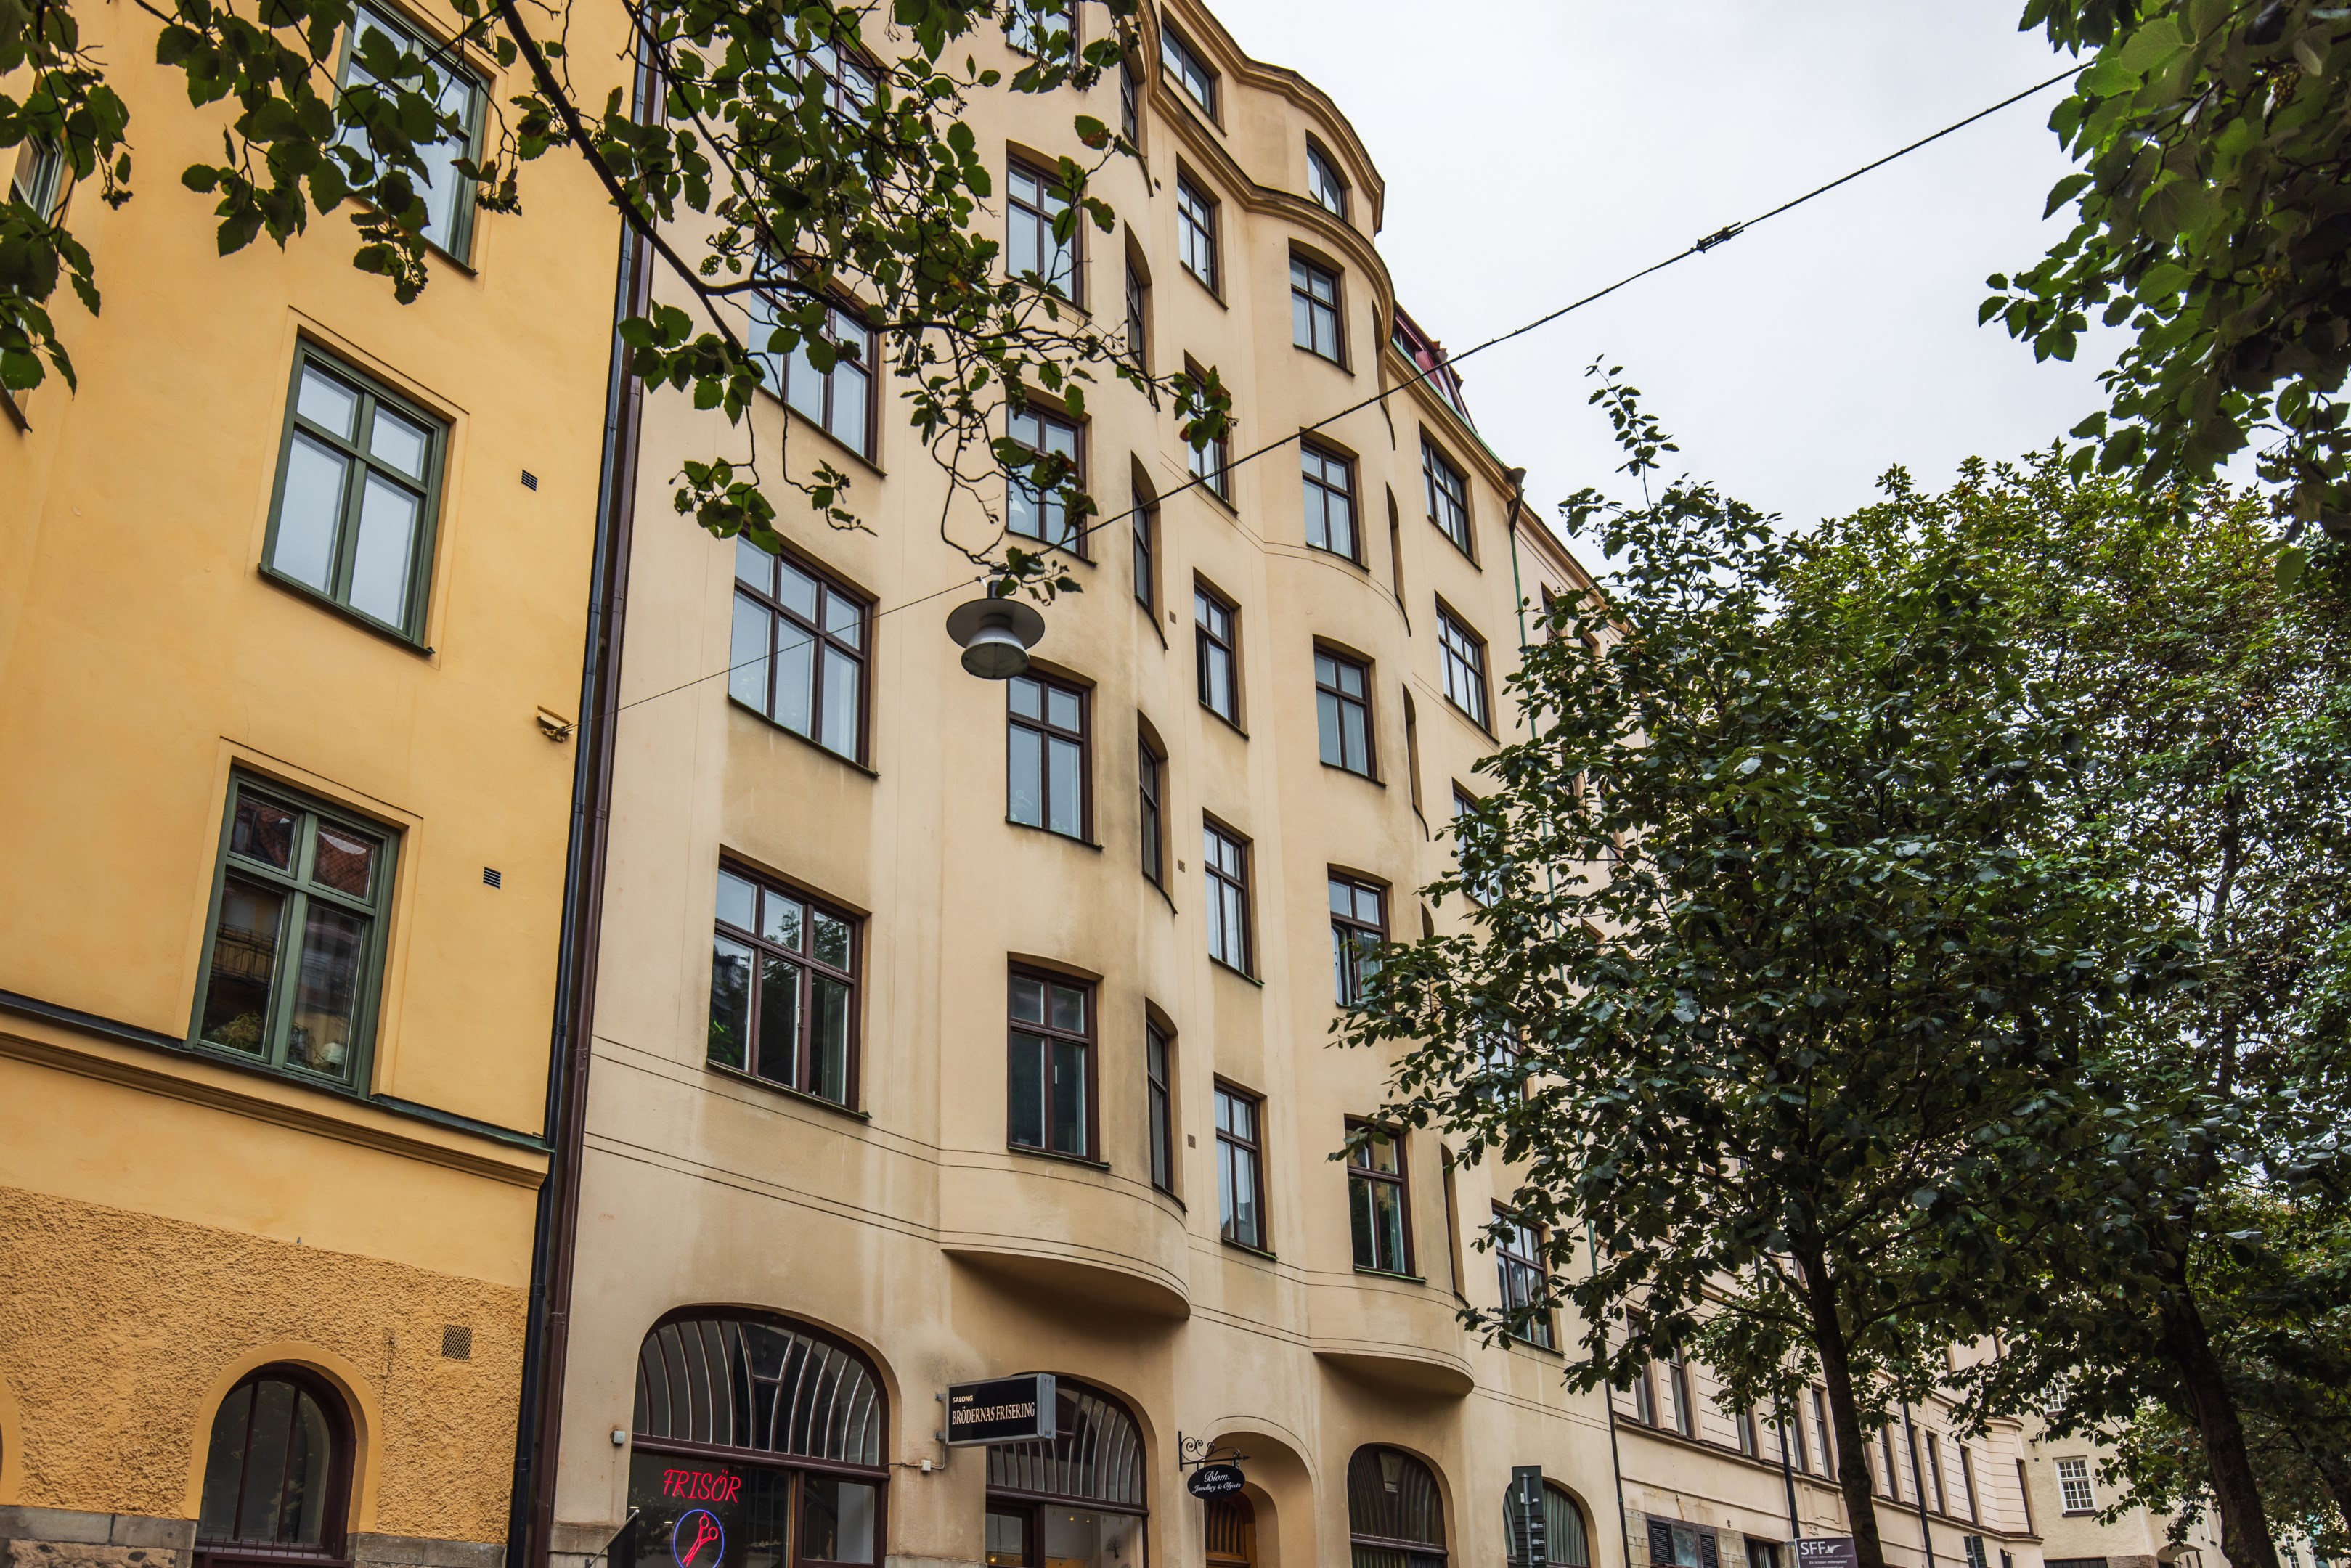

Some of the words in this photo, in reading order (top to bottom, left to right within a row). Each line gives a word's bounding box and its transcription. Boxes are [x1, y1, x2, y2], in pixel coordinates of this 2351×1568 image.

[952, 1406, 995, 1425] BRÖDERNAS
[996, 1402, 1035, 1421] FRISERING
[664, 1469, 741, 1503] FRISÖR
[1192, 1484, 1217, 1494] Jewellery
[1223, 1482, 1241, 1490] Objects
[1801, 1541, 1825, 1555] SFF
